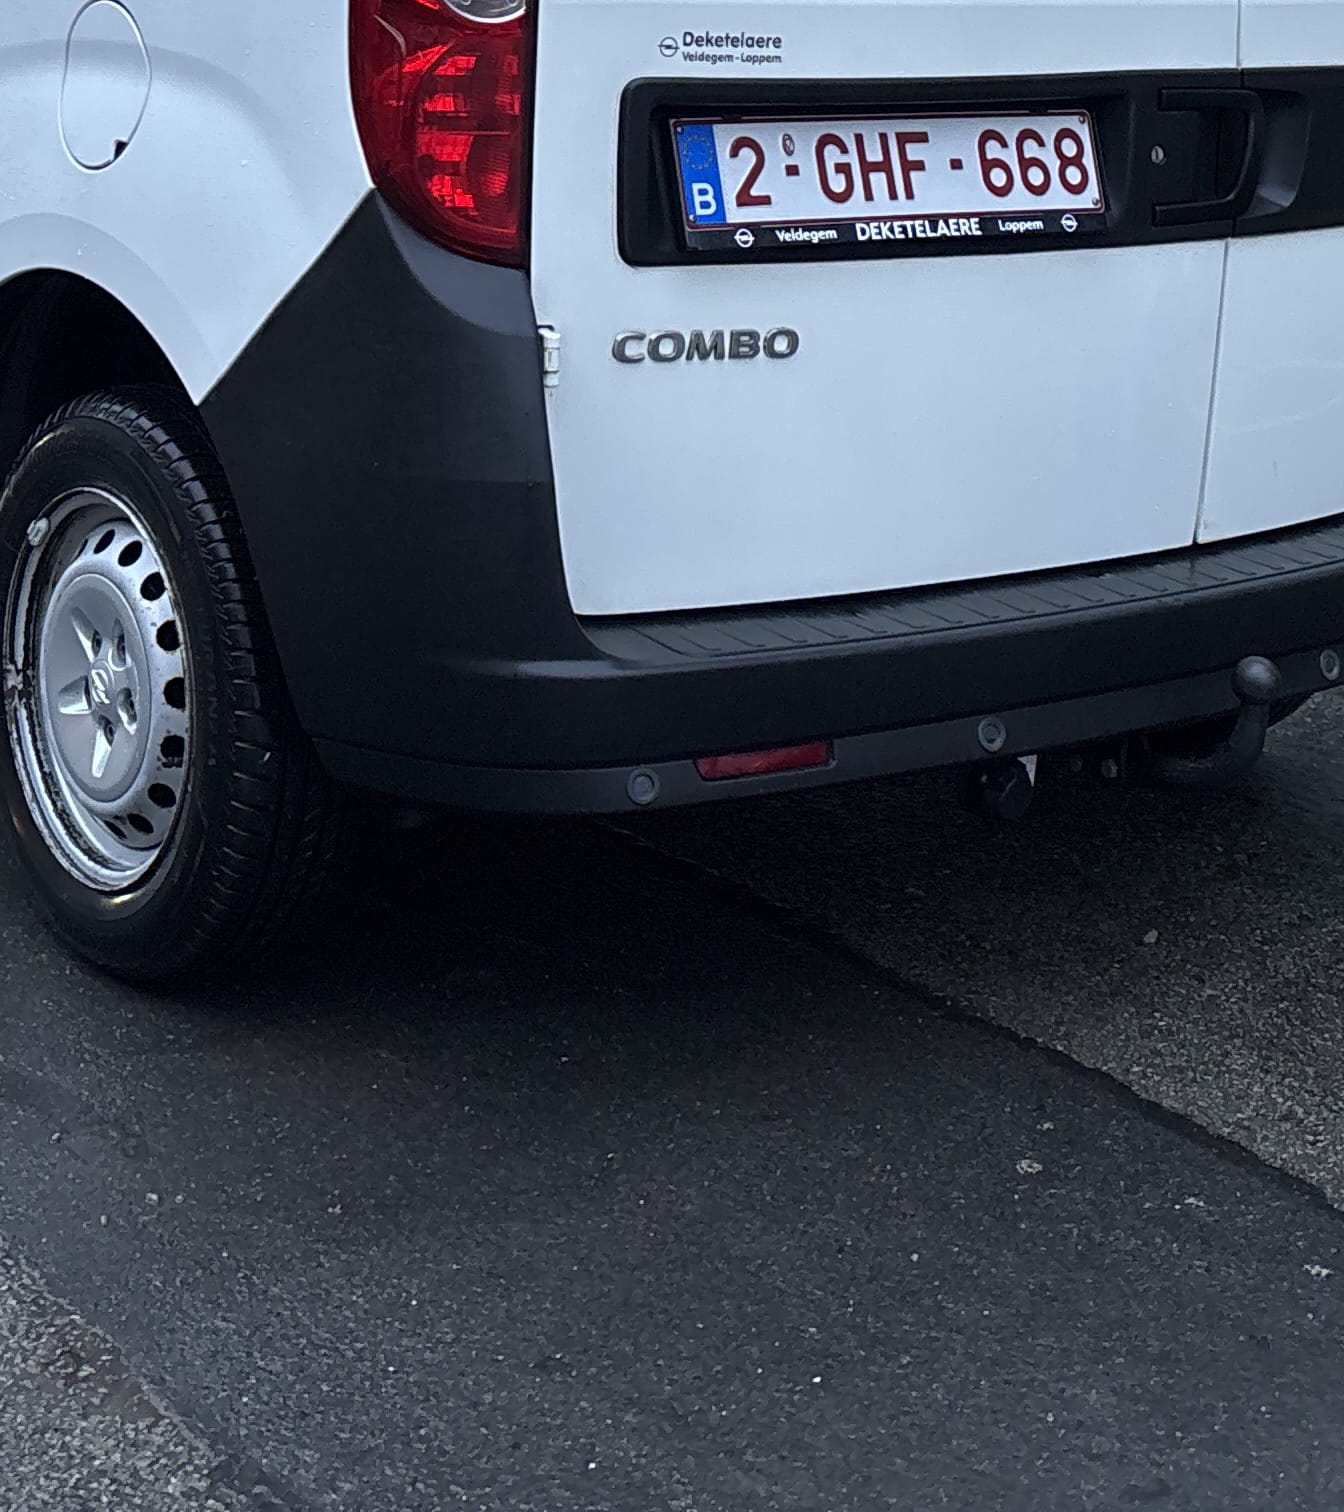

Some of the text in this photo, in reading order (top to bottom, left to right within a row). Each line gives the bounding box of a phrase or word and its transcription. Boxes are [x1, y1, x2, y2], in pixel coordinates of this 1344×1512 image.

[682, 31, 783, 49] Deketelaere
[691, 182, 717, 216] B
[775, 218, 1044, 244] Veldegem DEKETELAERE Loppem
[611, 326, 800, 364] COMBO
